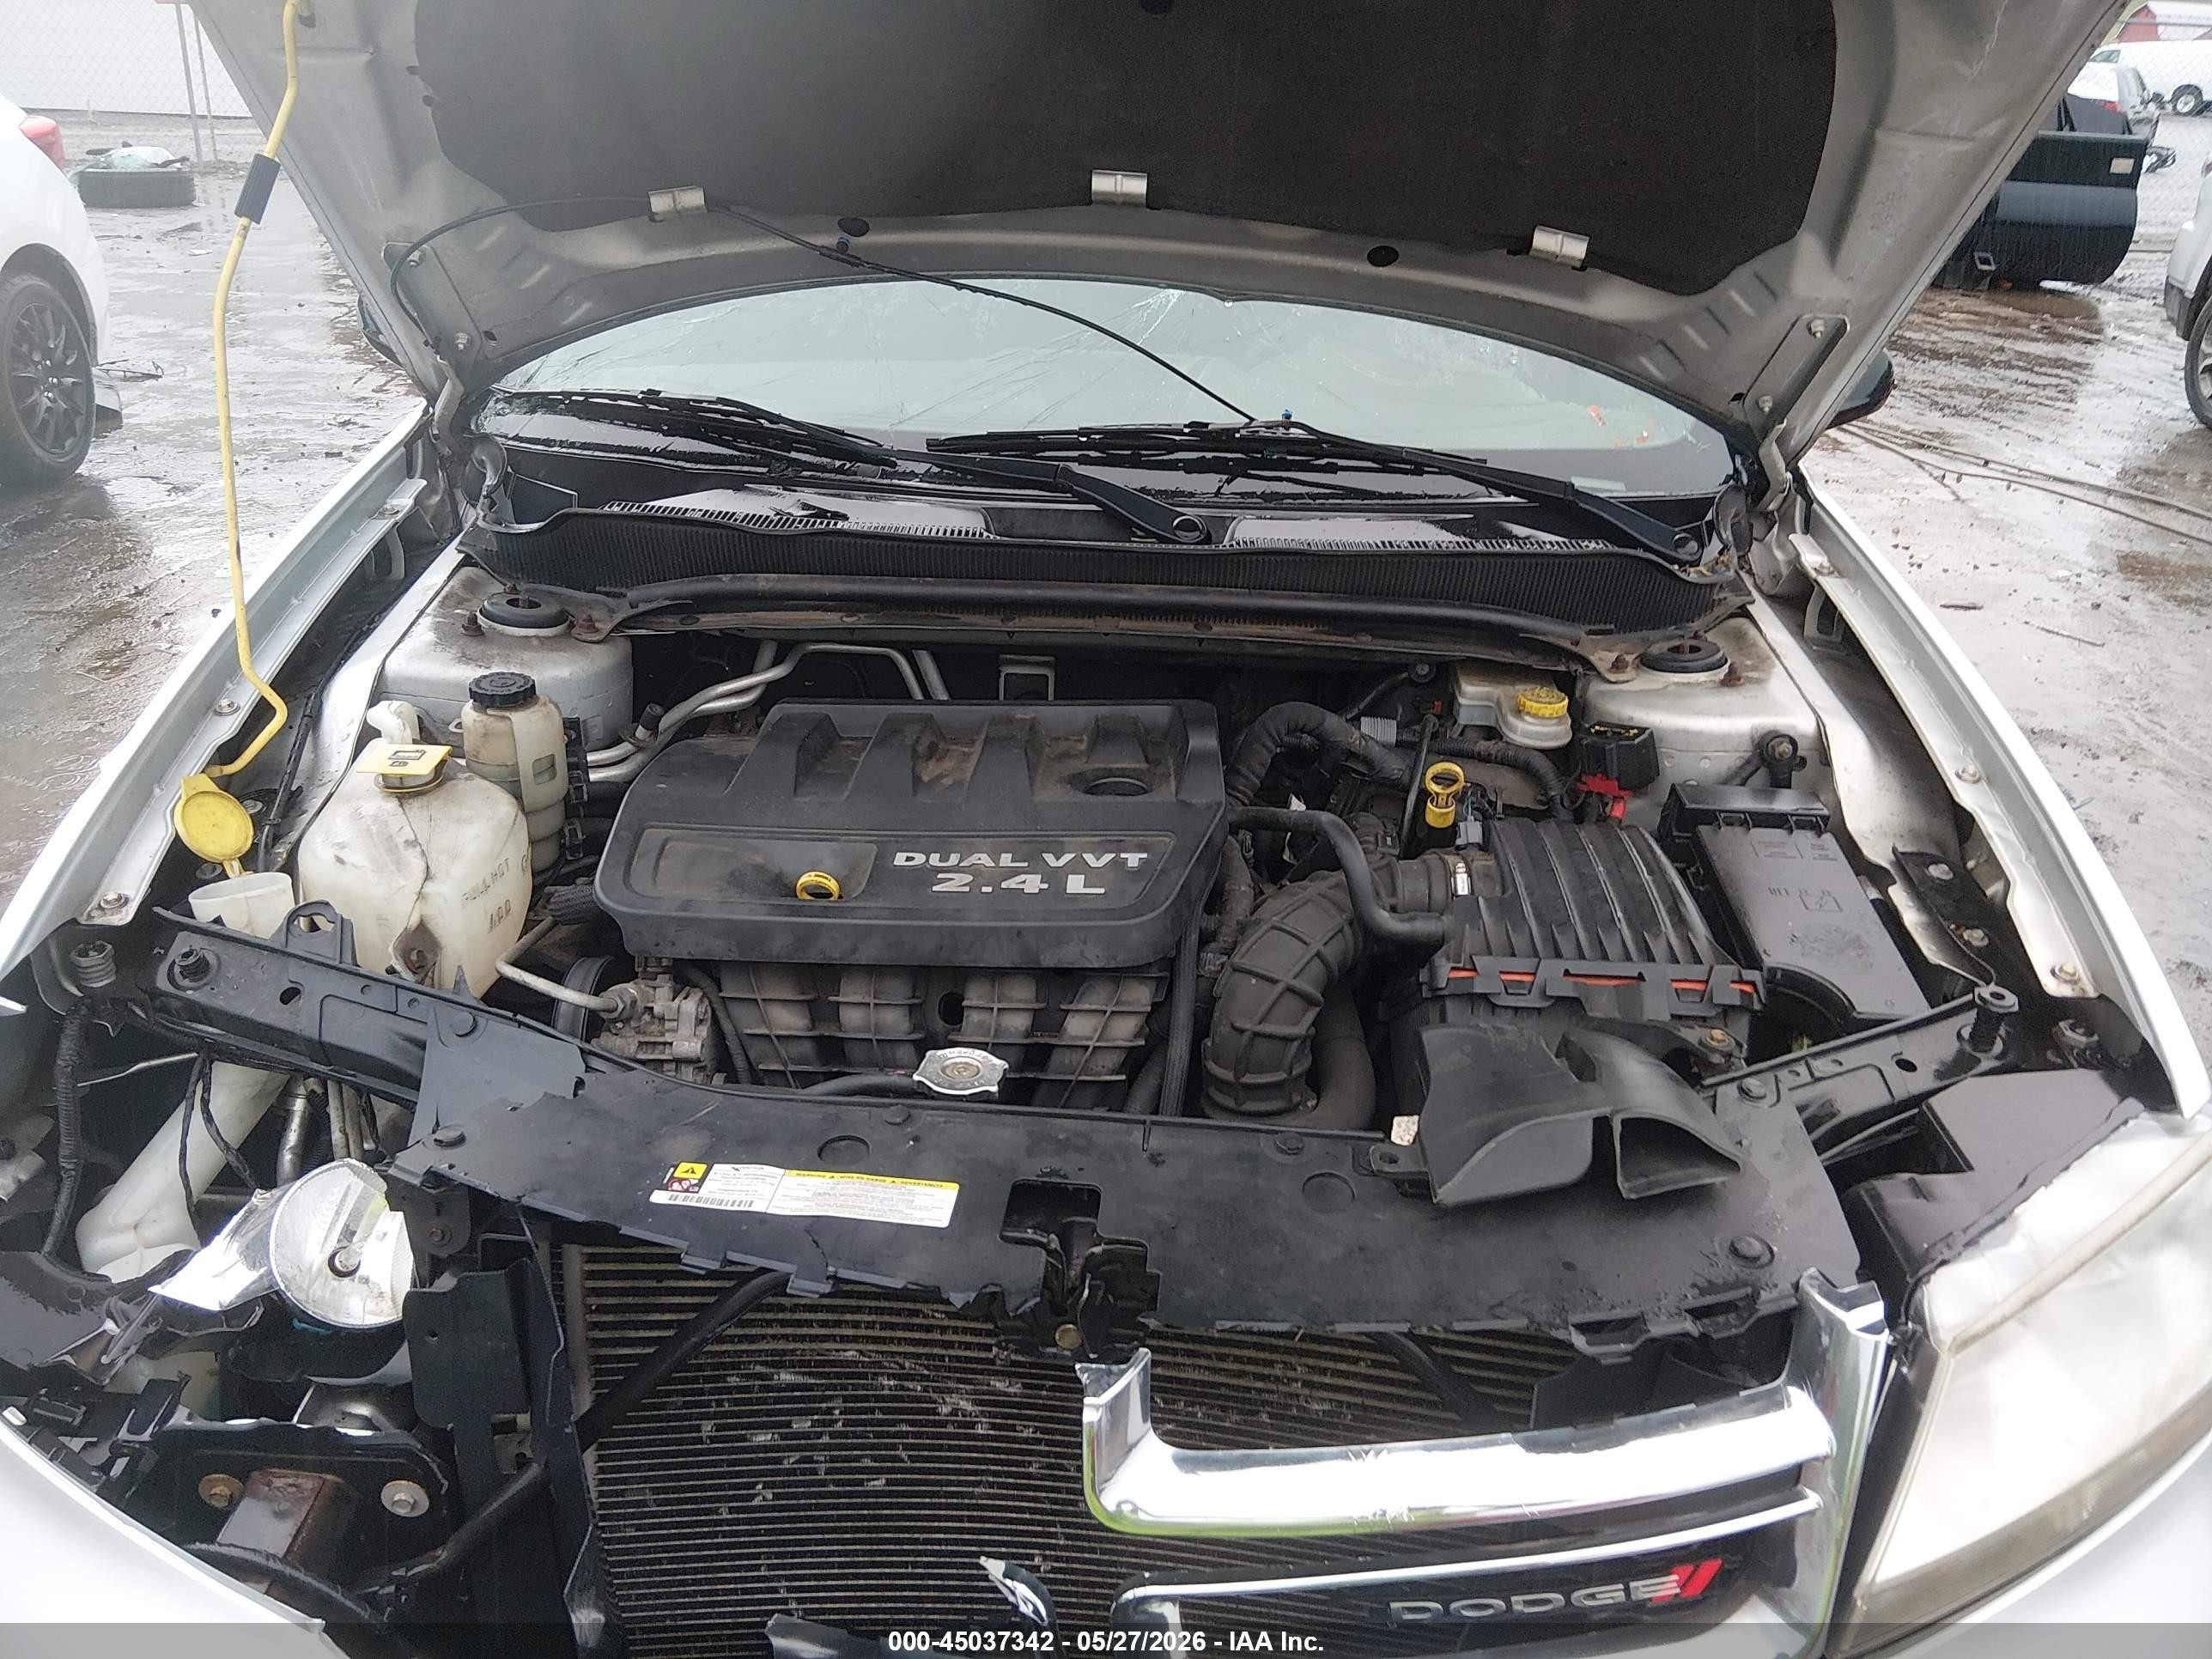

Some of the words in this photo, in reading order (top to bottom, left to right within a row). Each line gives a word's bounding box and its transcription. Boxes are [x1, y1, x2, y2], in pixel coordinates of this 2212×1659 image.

[893, 852, 1030, 868] DUAL
[1041, 852, 1149, 868] VVT
[1389, 1574, 1681, 1621] DODGE
